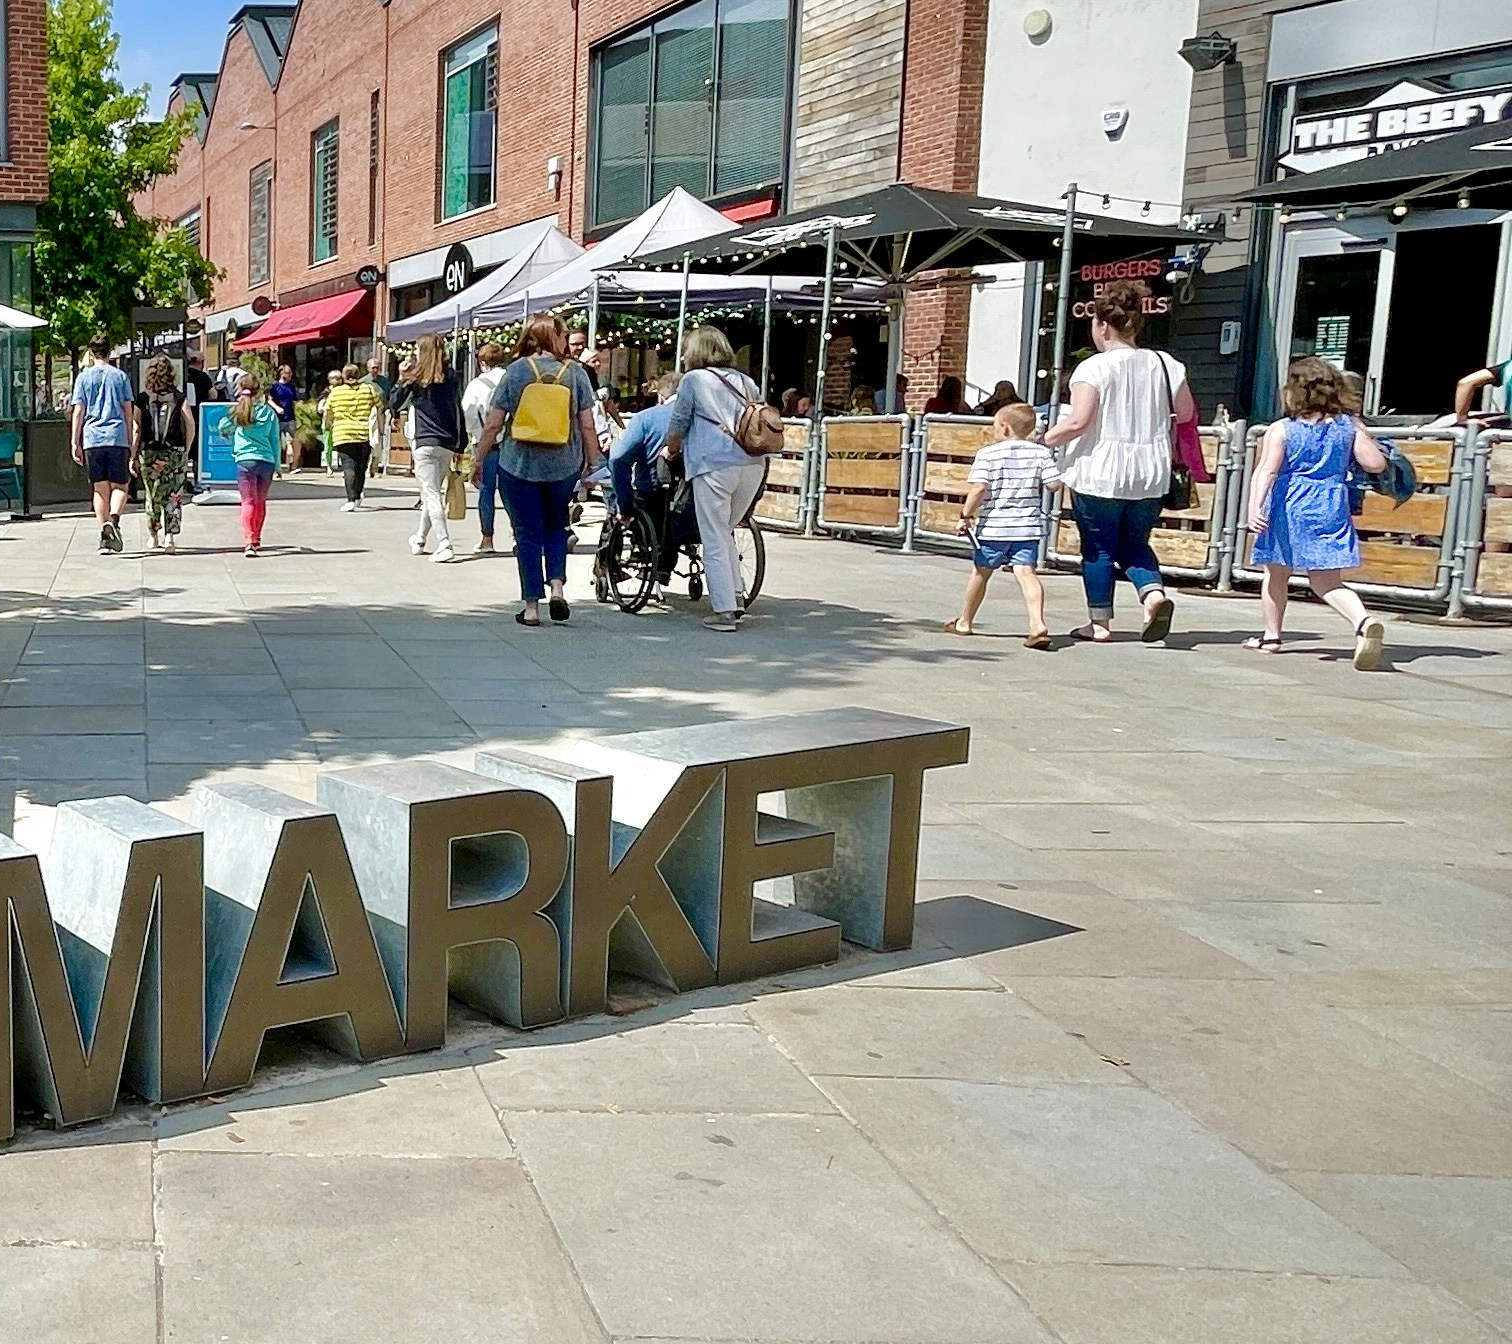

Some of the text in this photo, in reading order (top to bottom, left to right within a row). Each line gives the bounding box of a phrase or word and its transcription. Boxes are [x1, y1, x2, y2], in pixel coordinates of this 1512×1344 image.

[1296, 113, 1373, 149] THE
[1376, 92, 1512, 138] BEEFY
[1081, 259, 1161, 281] BURGERS
[1072, 296, 1169, 318] COILS
